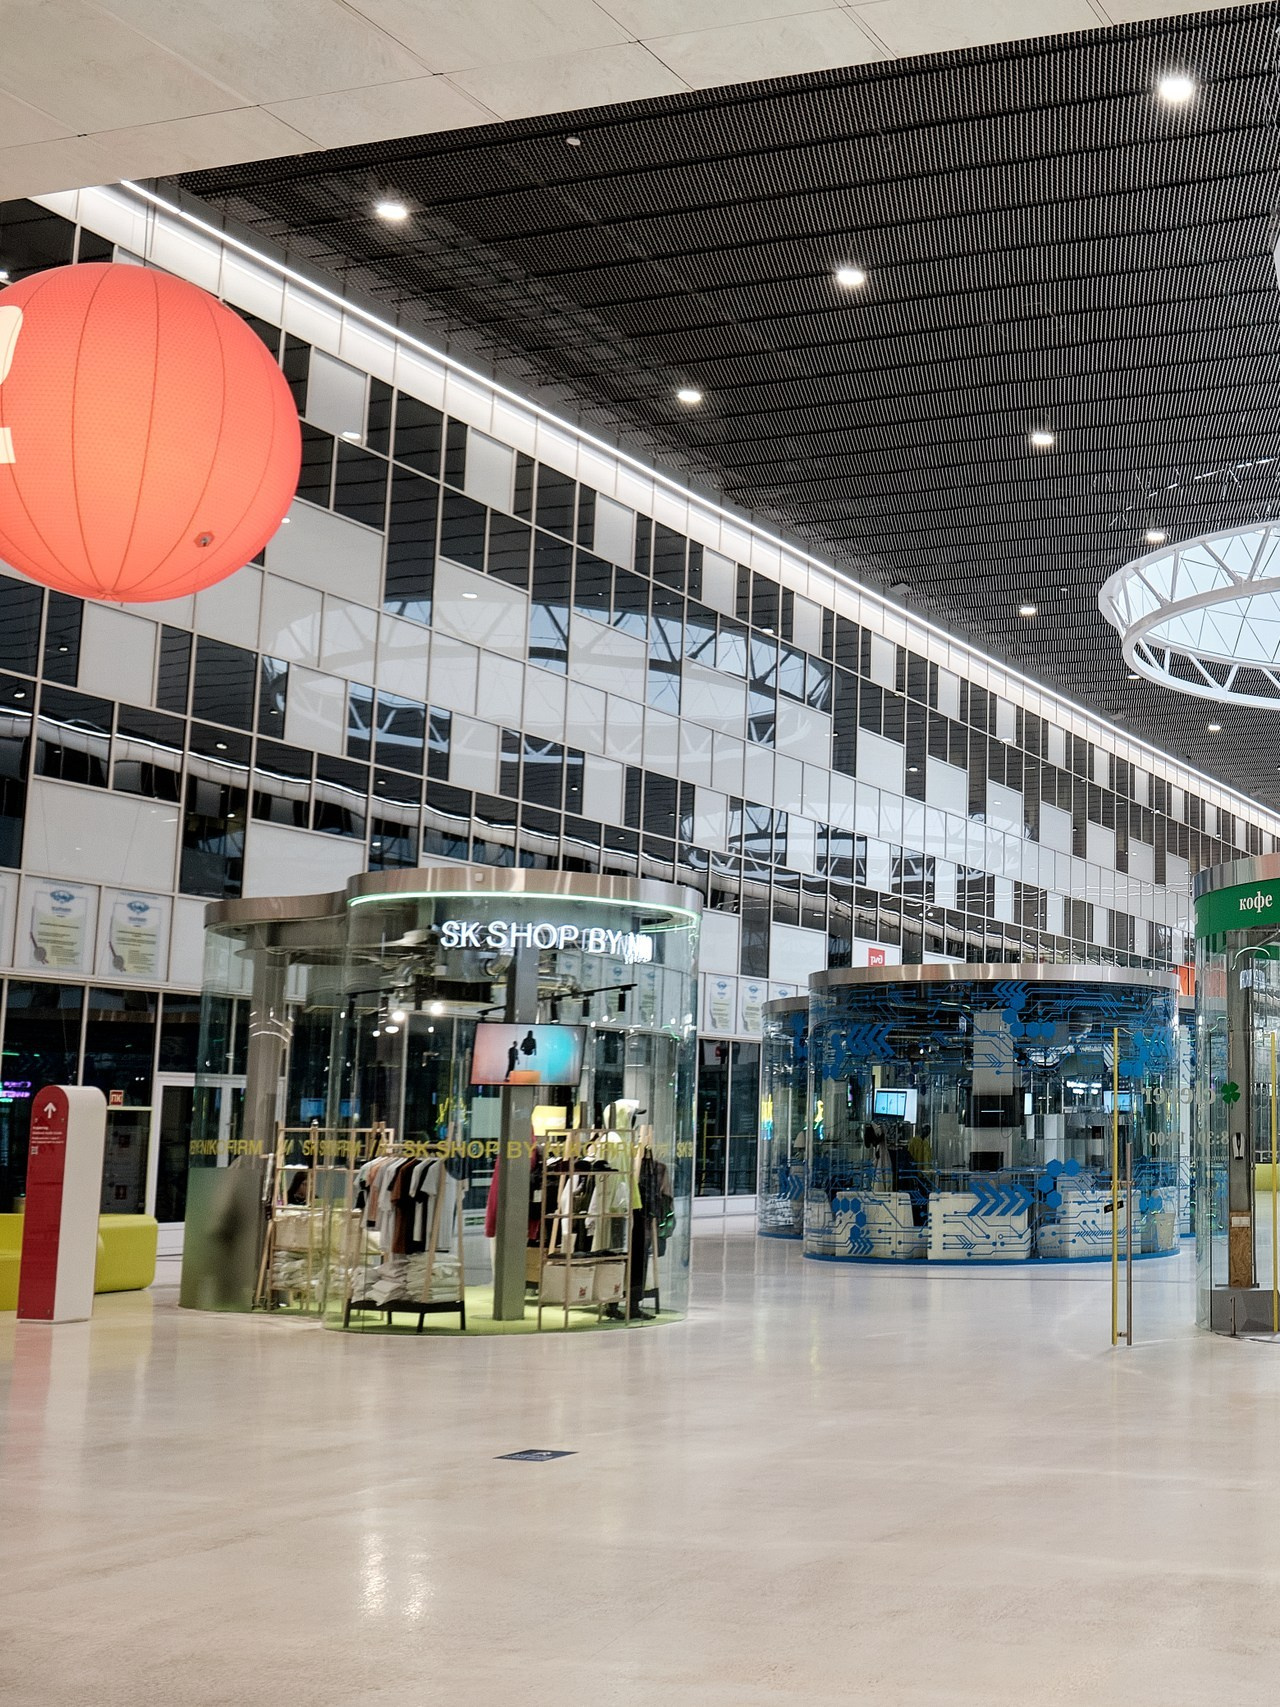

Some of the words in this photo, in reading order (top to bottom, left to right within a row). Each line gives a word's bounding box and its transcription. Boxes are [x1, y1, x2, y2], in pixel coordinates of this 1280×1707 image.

[1238, 890, 1273, 913] кофе
[440, 920, 481, 948] SK
[486, 920, 580, 951] SHOP
[588, 927, 623, 956] BY
[506, 1140, 537, 1160] BY
